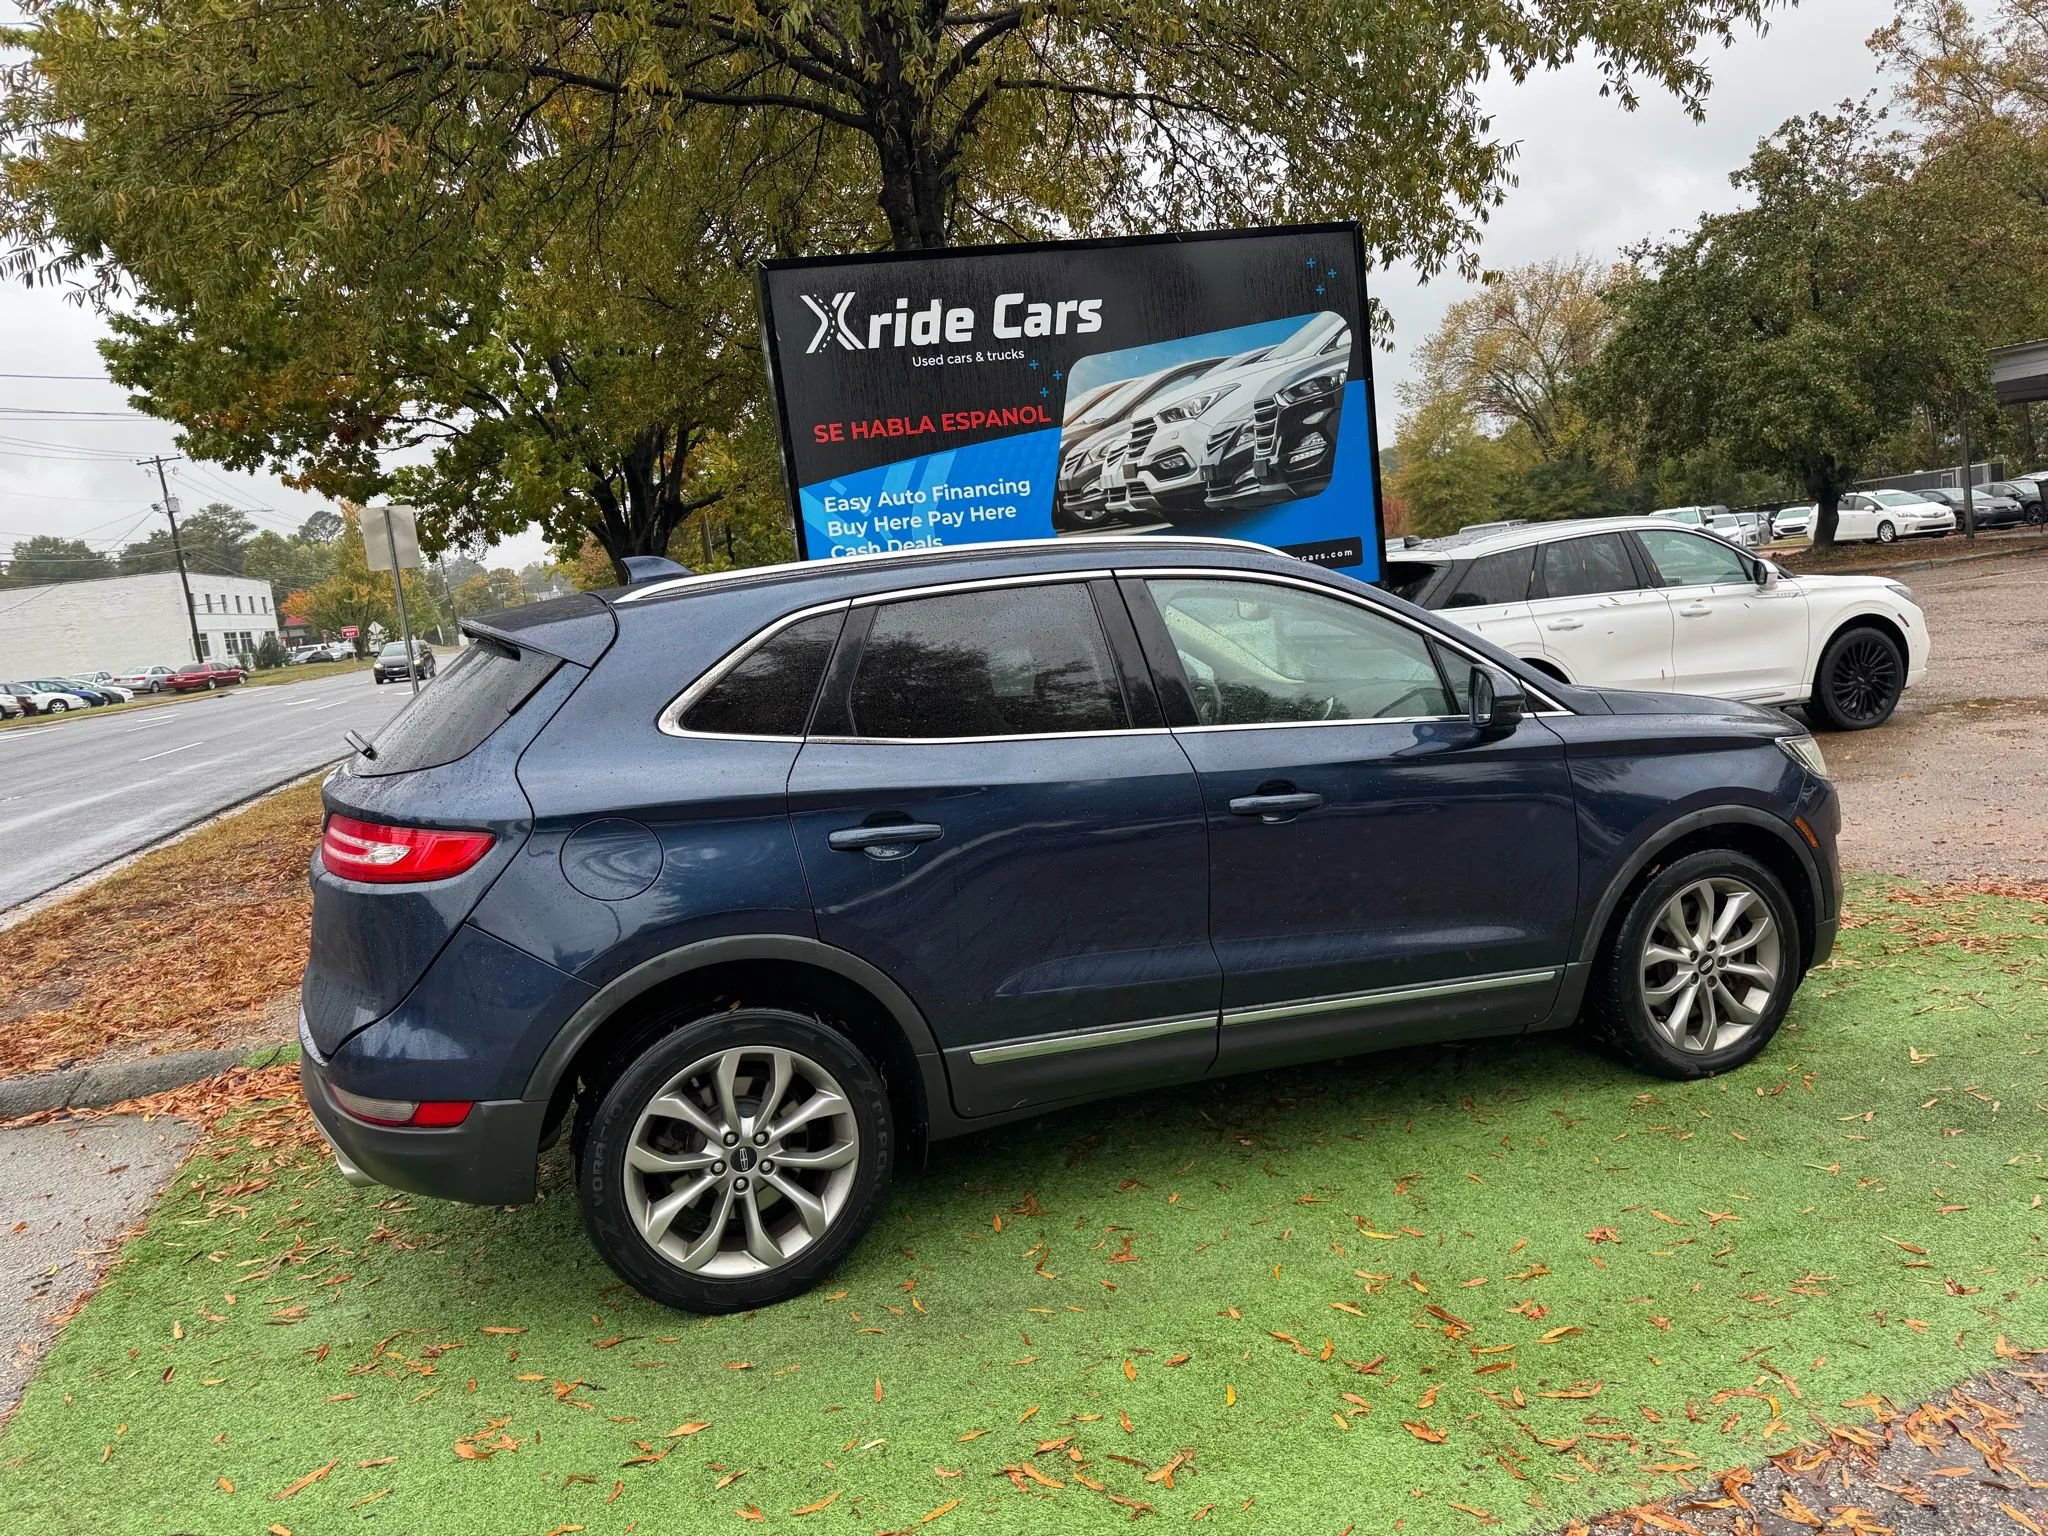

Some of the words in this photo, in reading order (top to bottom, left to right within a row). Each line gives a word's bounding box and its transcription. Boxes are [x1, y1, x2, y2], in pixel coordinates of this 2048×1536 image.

[993, 292, 1103, 339] Cars
[912, 354, 944, 367] Used
[947, 353, 973, 365] cars
[975, 351, 985, 363] &
[987, 348, 1025, 361] trucks
[813, 422, 845, 444] SE
[851, 415, 936, 440] HABLA
[941, 404, 1051, 432] ESPANOL
[824, 495, 872, 514] Easy
[877, 490, 927, 508] Auto
[932, 478, 1031, 502] Financing
[827, 520, 868, 538] Buy
[874, 515, 923, 532] Here
[928, 510, 964, 528] Pay
[970, 505, 1017, 522] Here
[831, 541, 881, 558] Cash
[887, 535, 944, 552] Deals
